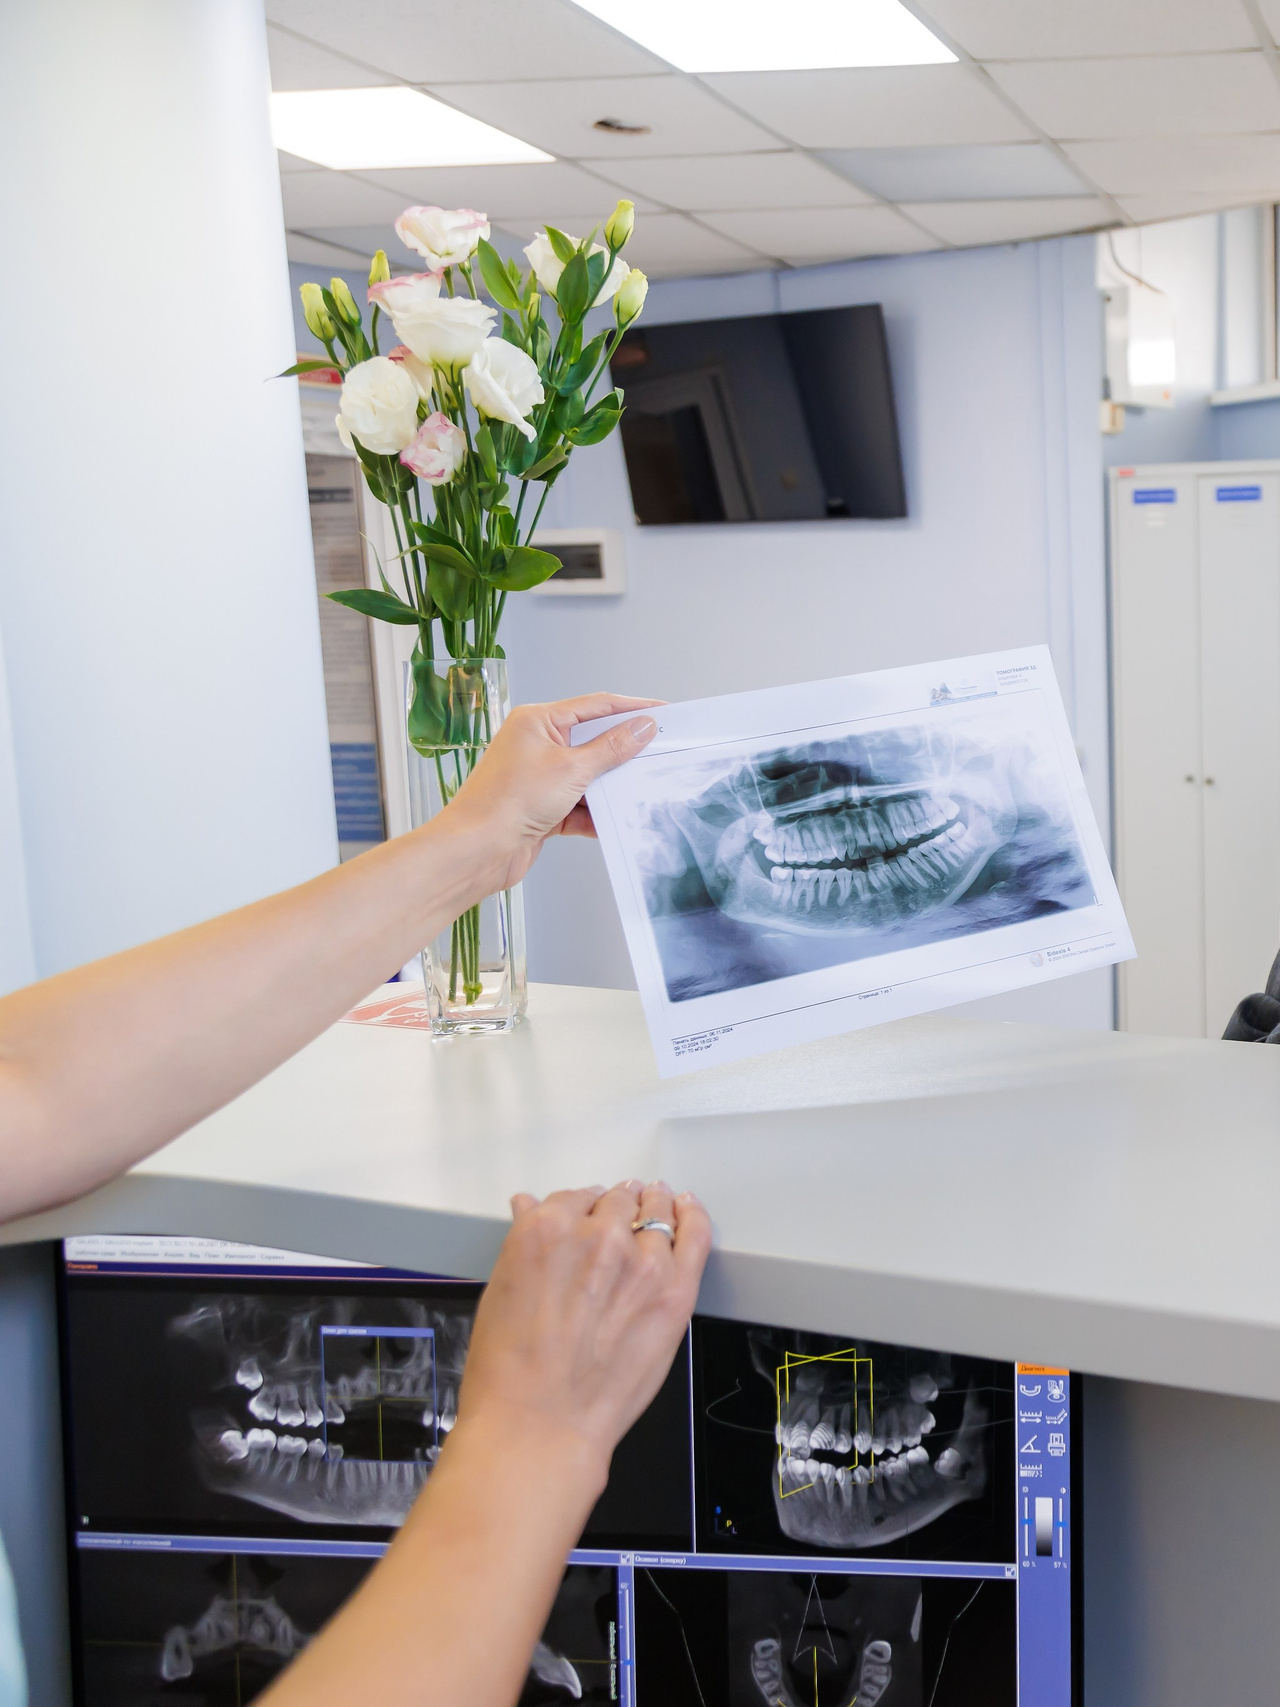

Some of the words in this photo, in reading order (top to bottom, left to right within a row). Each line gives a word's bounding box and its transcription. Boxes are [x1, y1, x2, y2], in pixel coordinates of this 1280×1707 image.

[996, 666, 1029, 675] ТОМОГРАФИЯ
[1046, 948, 1067, 958] Sidexis
[726, 1519, 733, 1528] P
